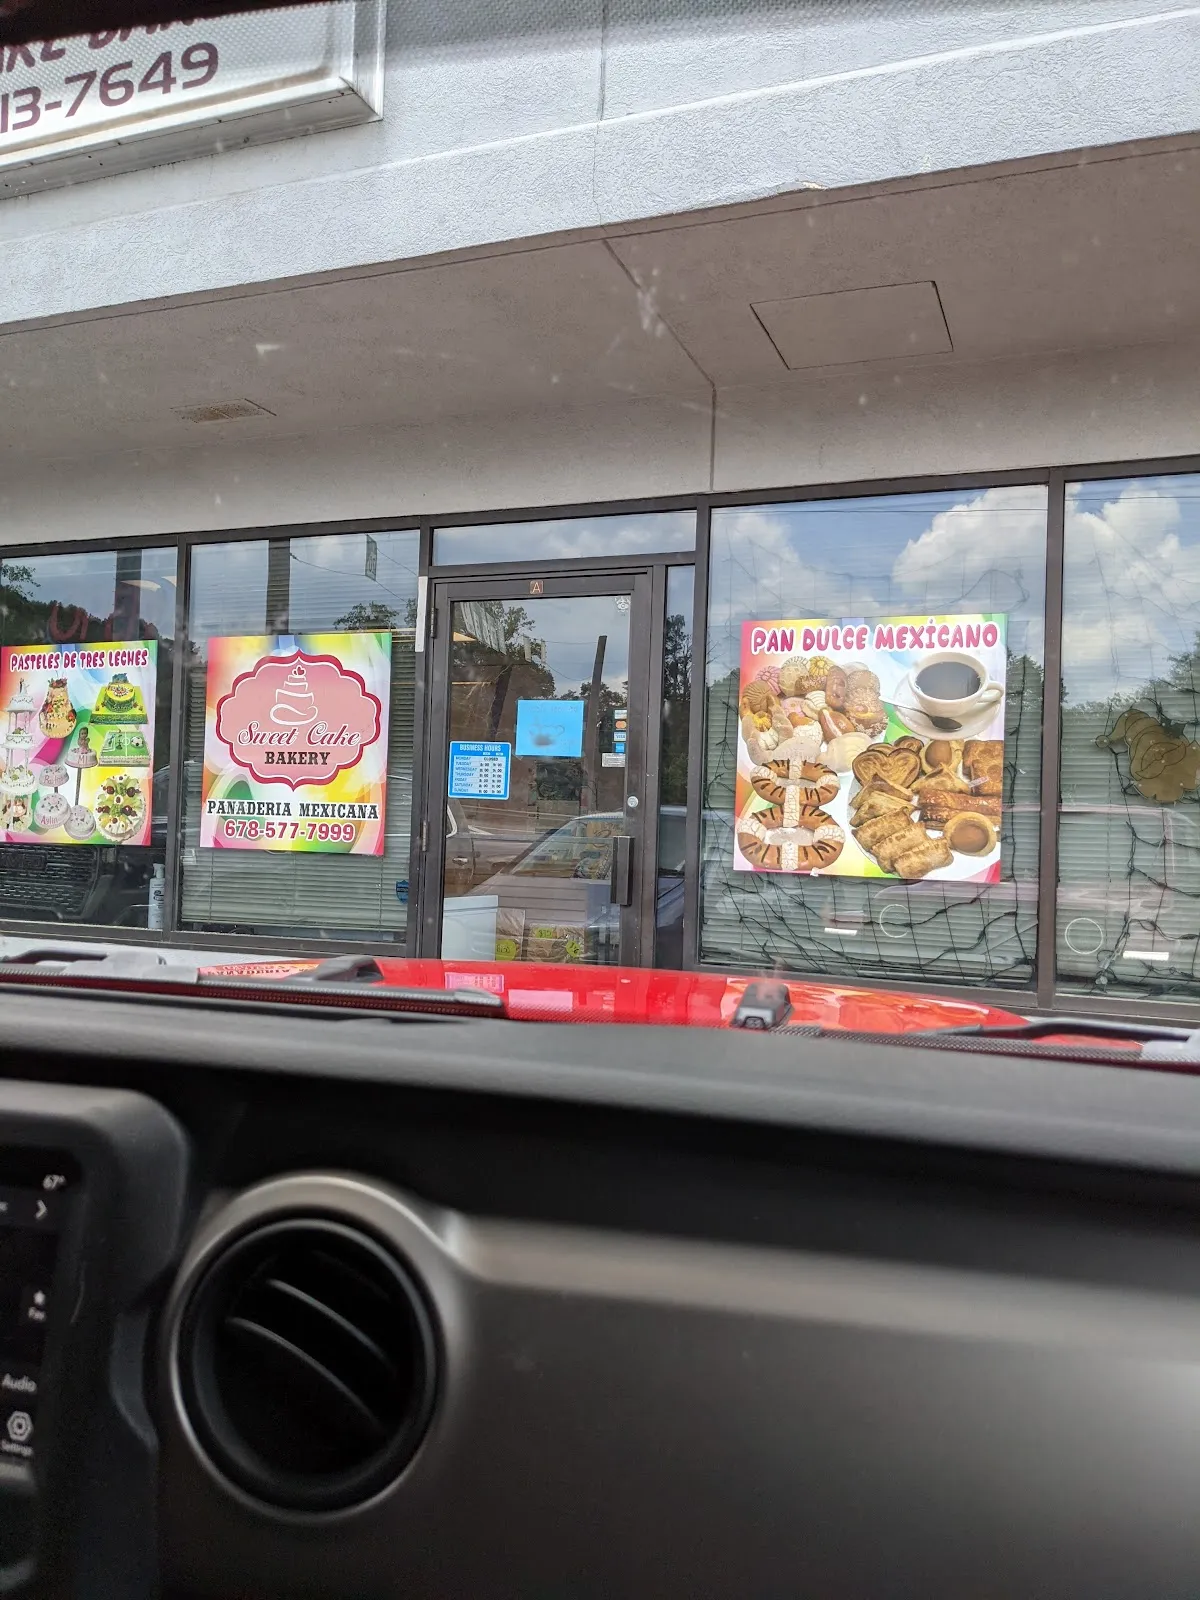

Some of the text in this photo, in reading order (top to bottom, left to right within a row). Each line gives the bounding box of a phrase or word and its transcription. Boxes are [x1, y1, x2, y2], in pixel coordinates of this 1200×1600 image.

[532, 581, 541, 593] A
[752, 628, 794, 653] PAN
[802, 626, 868, 651] DULCE
[11, 650, 148, 671] PASTELES DE TRES LECHES
[238, 721, 360, 746] Sweet Cake
[265, 751, 330, 765] BAKERY
[207, 800, 379, 819] PANADERIA MEXICANA
[225, 821, 354, 842] 678-577-7999
[2, 1373, 37, 1393] Audio
